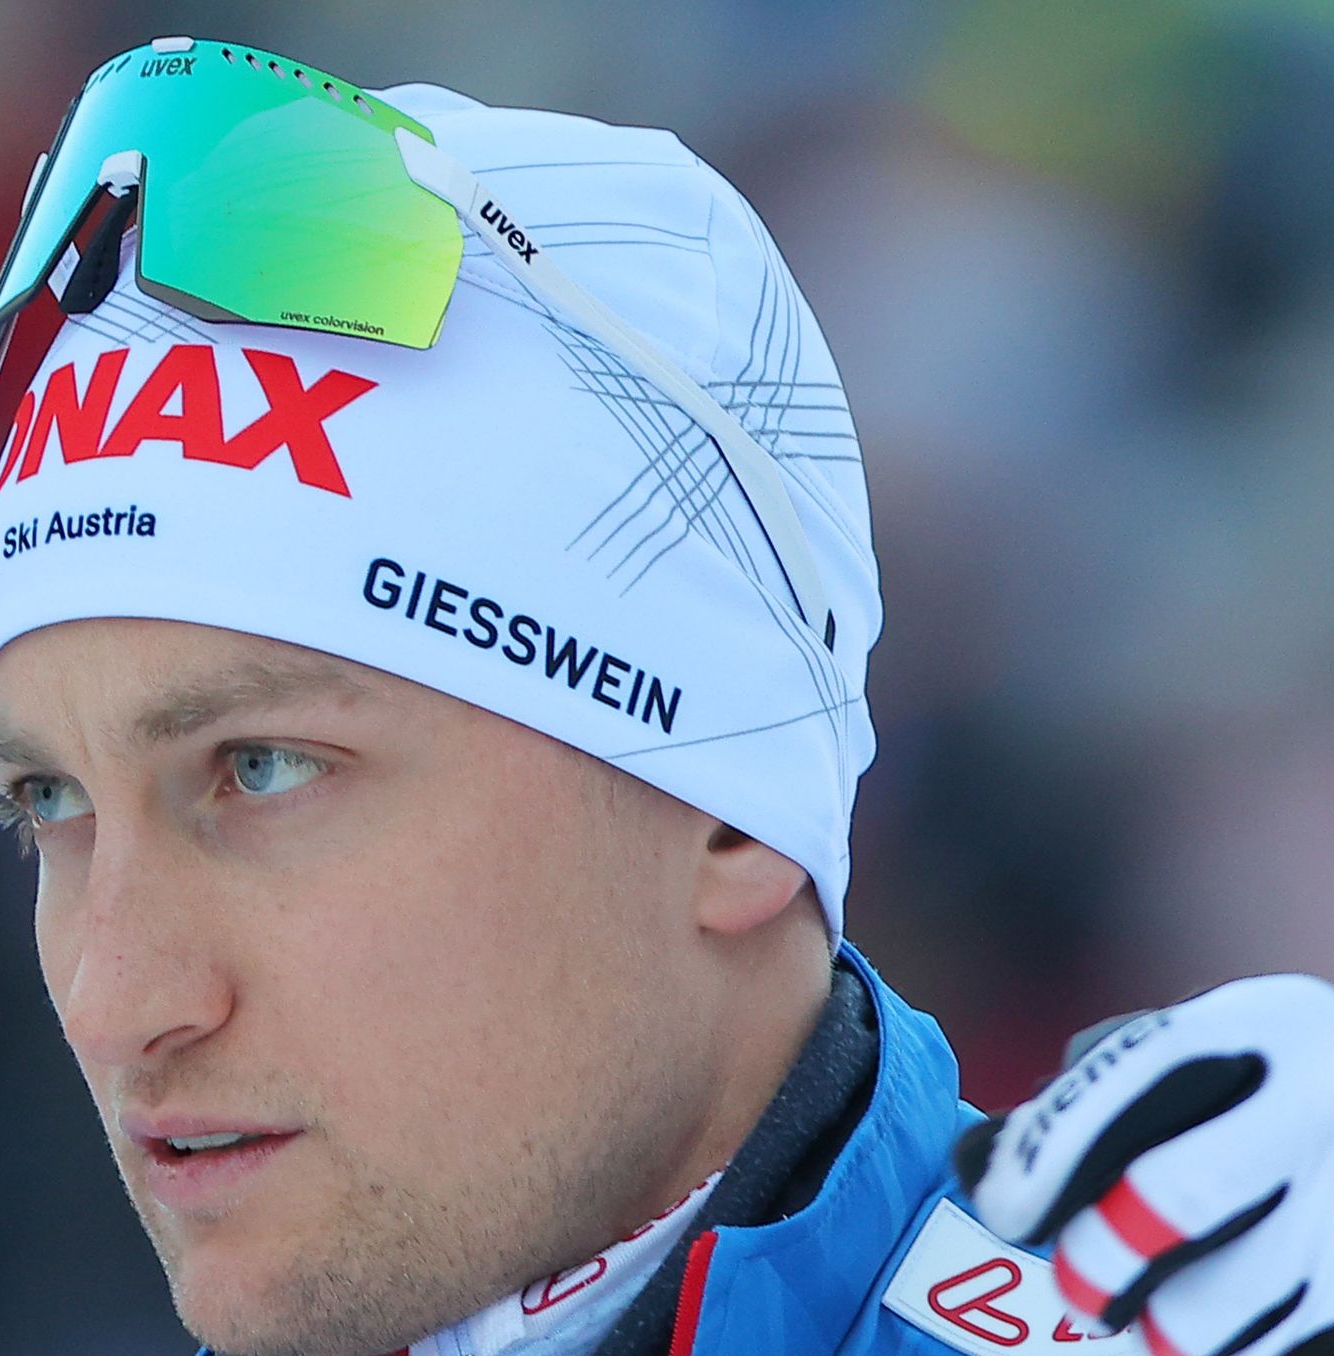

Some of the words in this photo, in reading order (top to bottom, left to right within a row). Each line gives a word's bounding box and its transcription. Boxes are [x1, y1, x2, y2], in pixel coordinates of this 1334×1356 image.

[140, 57, 198, 77] uvex
[479, 199, 540, 266] uvex
[280, 311, 311, 323] uvex
[313, 315, 385, 336] colorvision
[2, 518, 38, 559] Ski
[45, 505, 156, 544] Austria
[362, 558, 682, 735] GIESSWEIN
